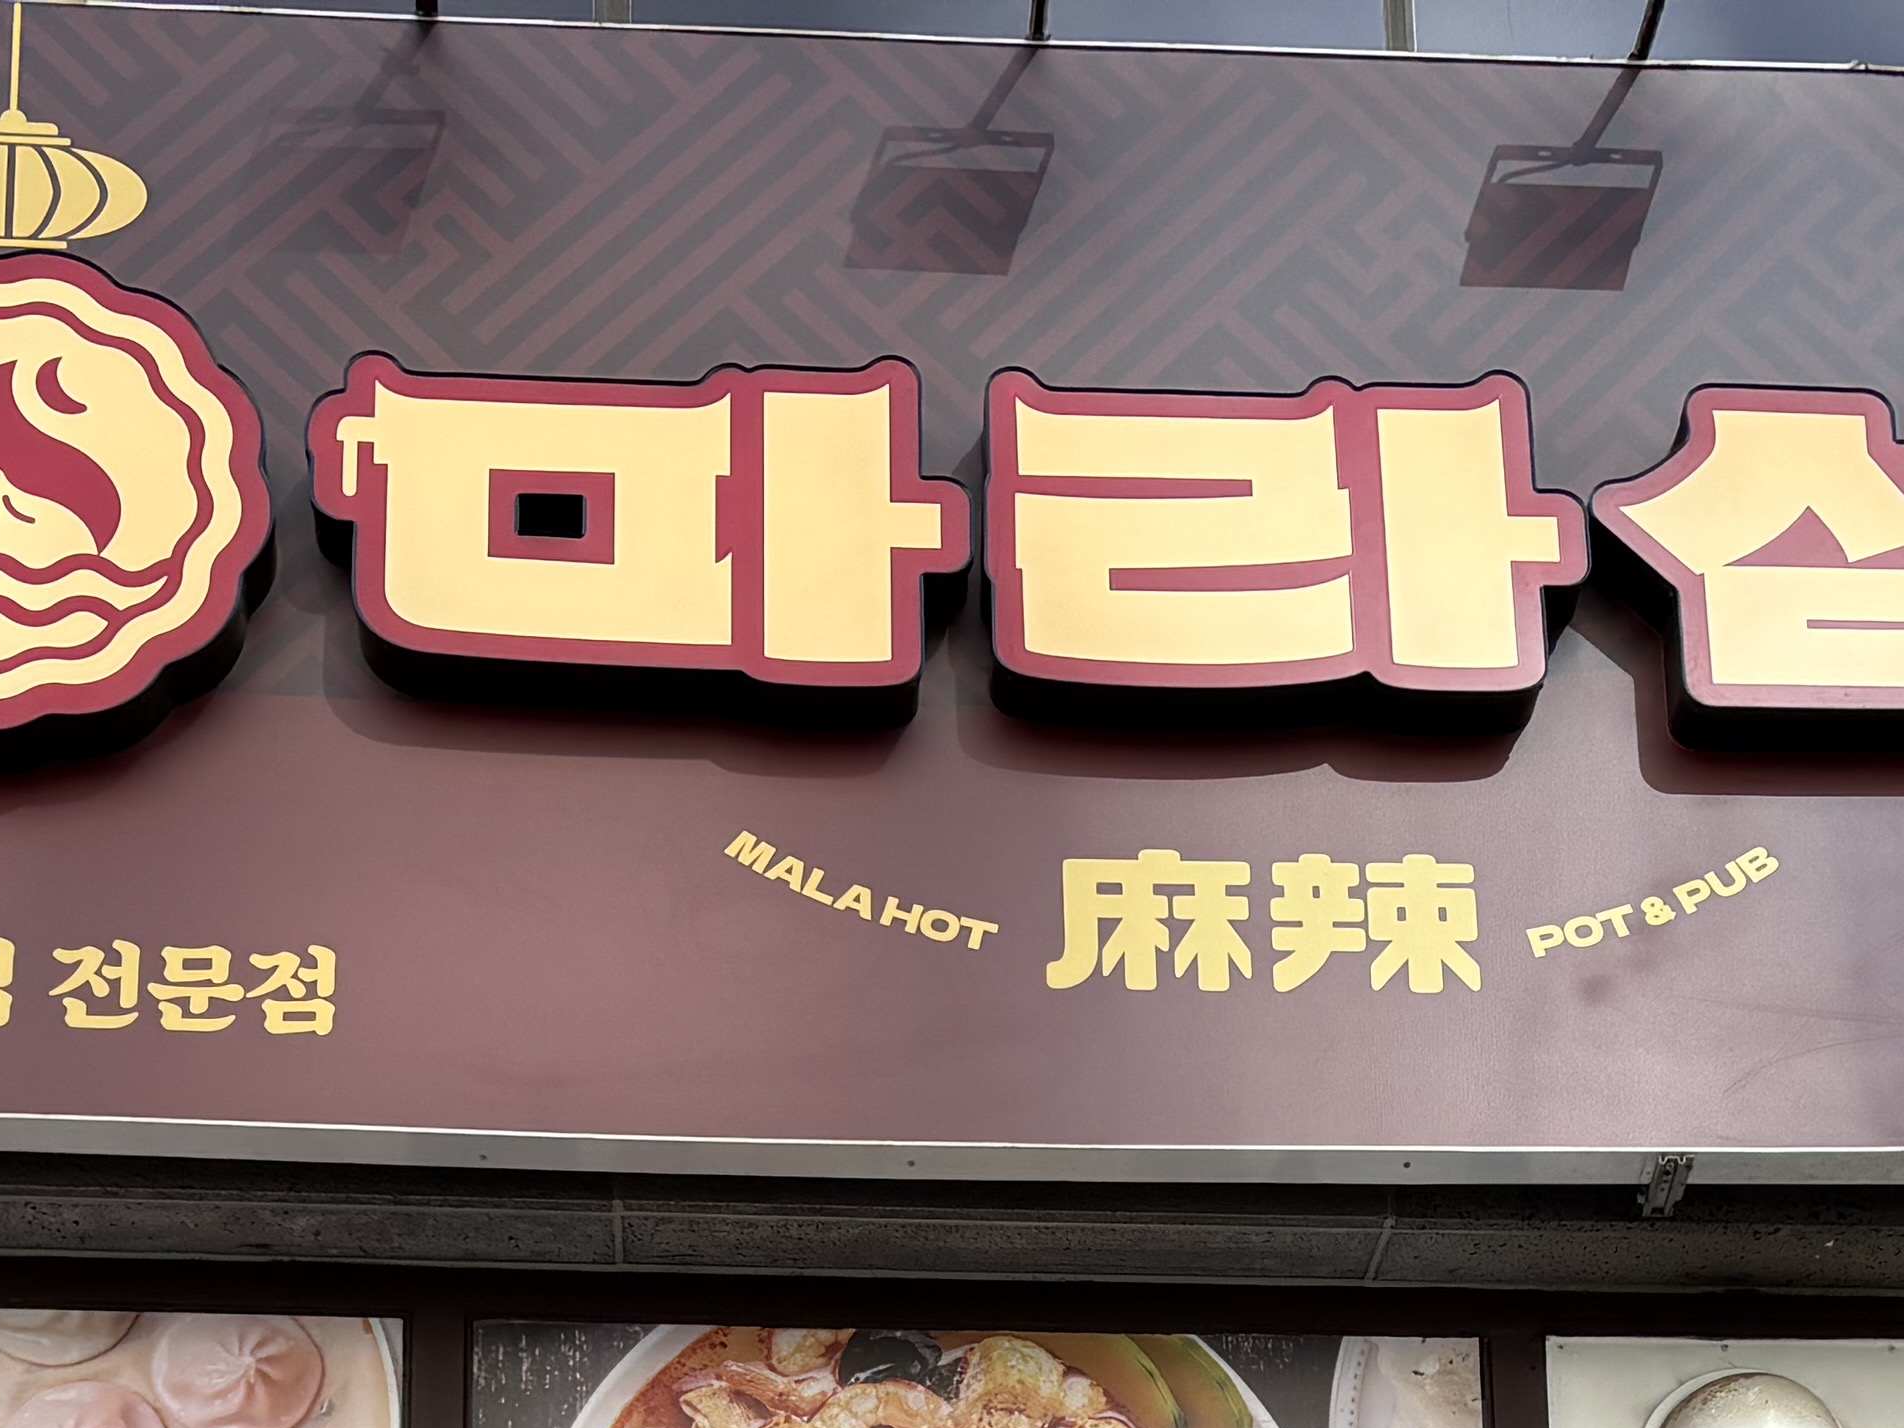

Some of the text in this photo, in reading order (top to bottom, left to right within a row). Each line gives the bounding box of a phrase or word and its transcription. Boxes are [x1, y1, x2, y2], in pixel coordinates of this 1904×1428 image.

[724, 830, 999, 951] MALA HOT
[1046, 849, 1481, 994] 麻辣
[1525, 845, 1781, 958] POT & PUB
[49, 939, 338, 1036] 전문점
